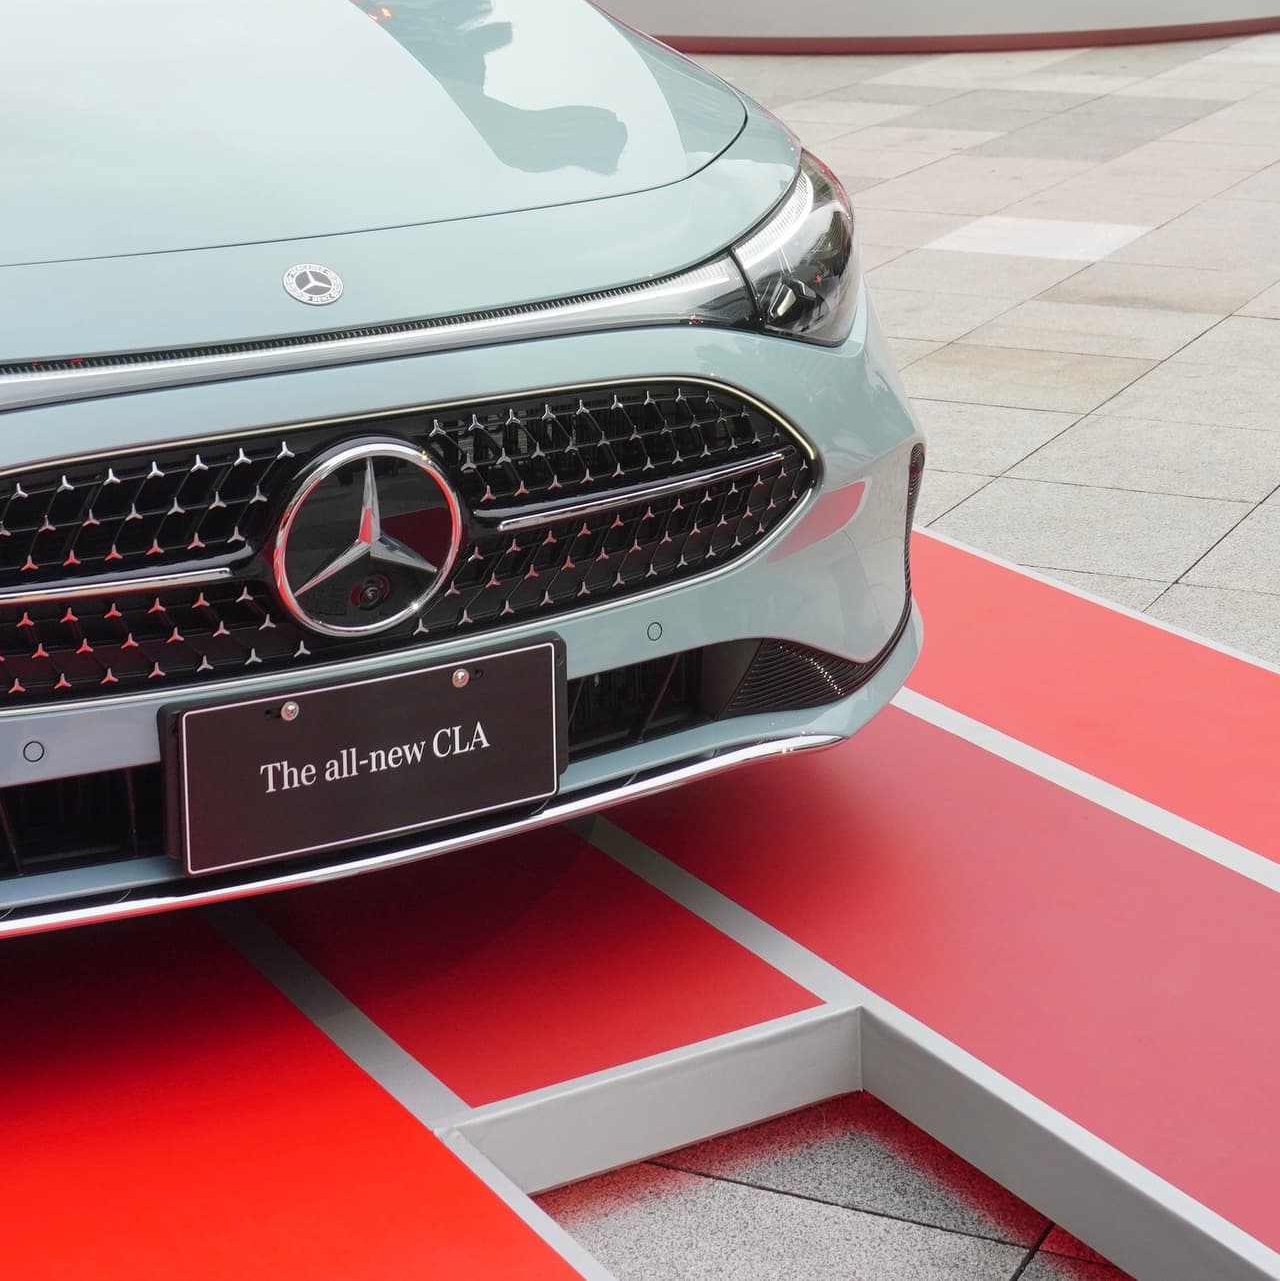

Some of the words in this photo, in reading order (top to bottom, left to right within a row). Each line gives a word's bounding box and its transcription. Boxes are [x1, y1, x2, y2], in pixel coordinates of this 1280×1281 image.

[259, 760, 317, 794] The
[325, 741, 426, 783] all-new
[432, 720, 490, 759] CLA
